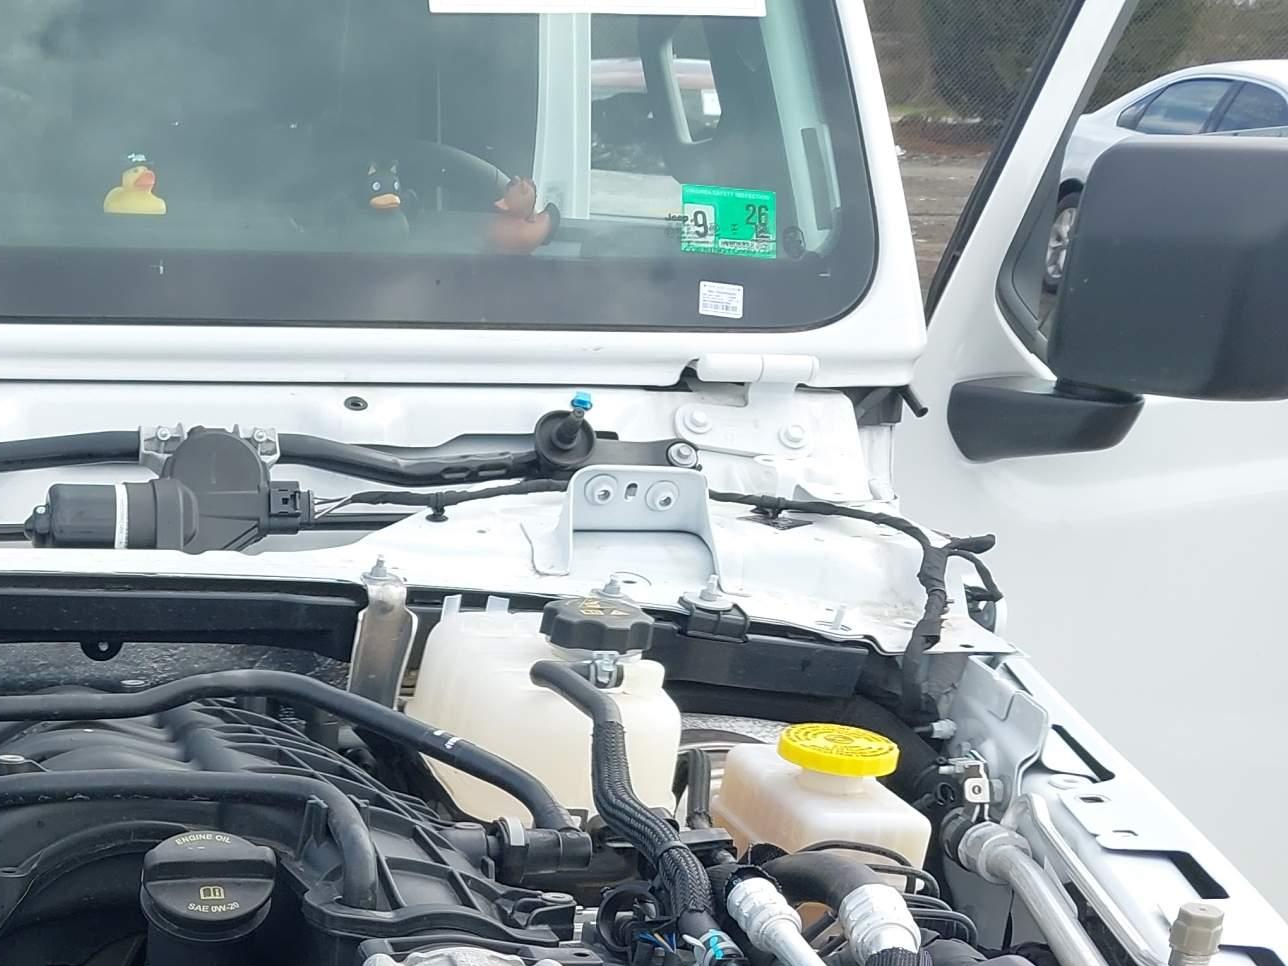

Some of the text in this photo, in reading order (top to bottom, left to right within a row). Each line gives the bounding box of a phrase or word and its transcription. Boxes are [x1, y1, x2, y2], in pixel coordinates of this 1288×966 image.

[745, 204, 768, 225] 26
[693, 210, 708, 238] 9
[175, 833, 233, 845] ENGINE OIL
[187, 901, 240, 912] SAE 0W-20
